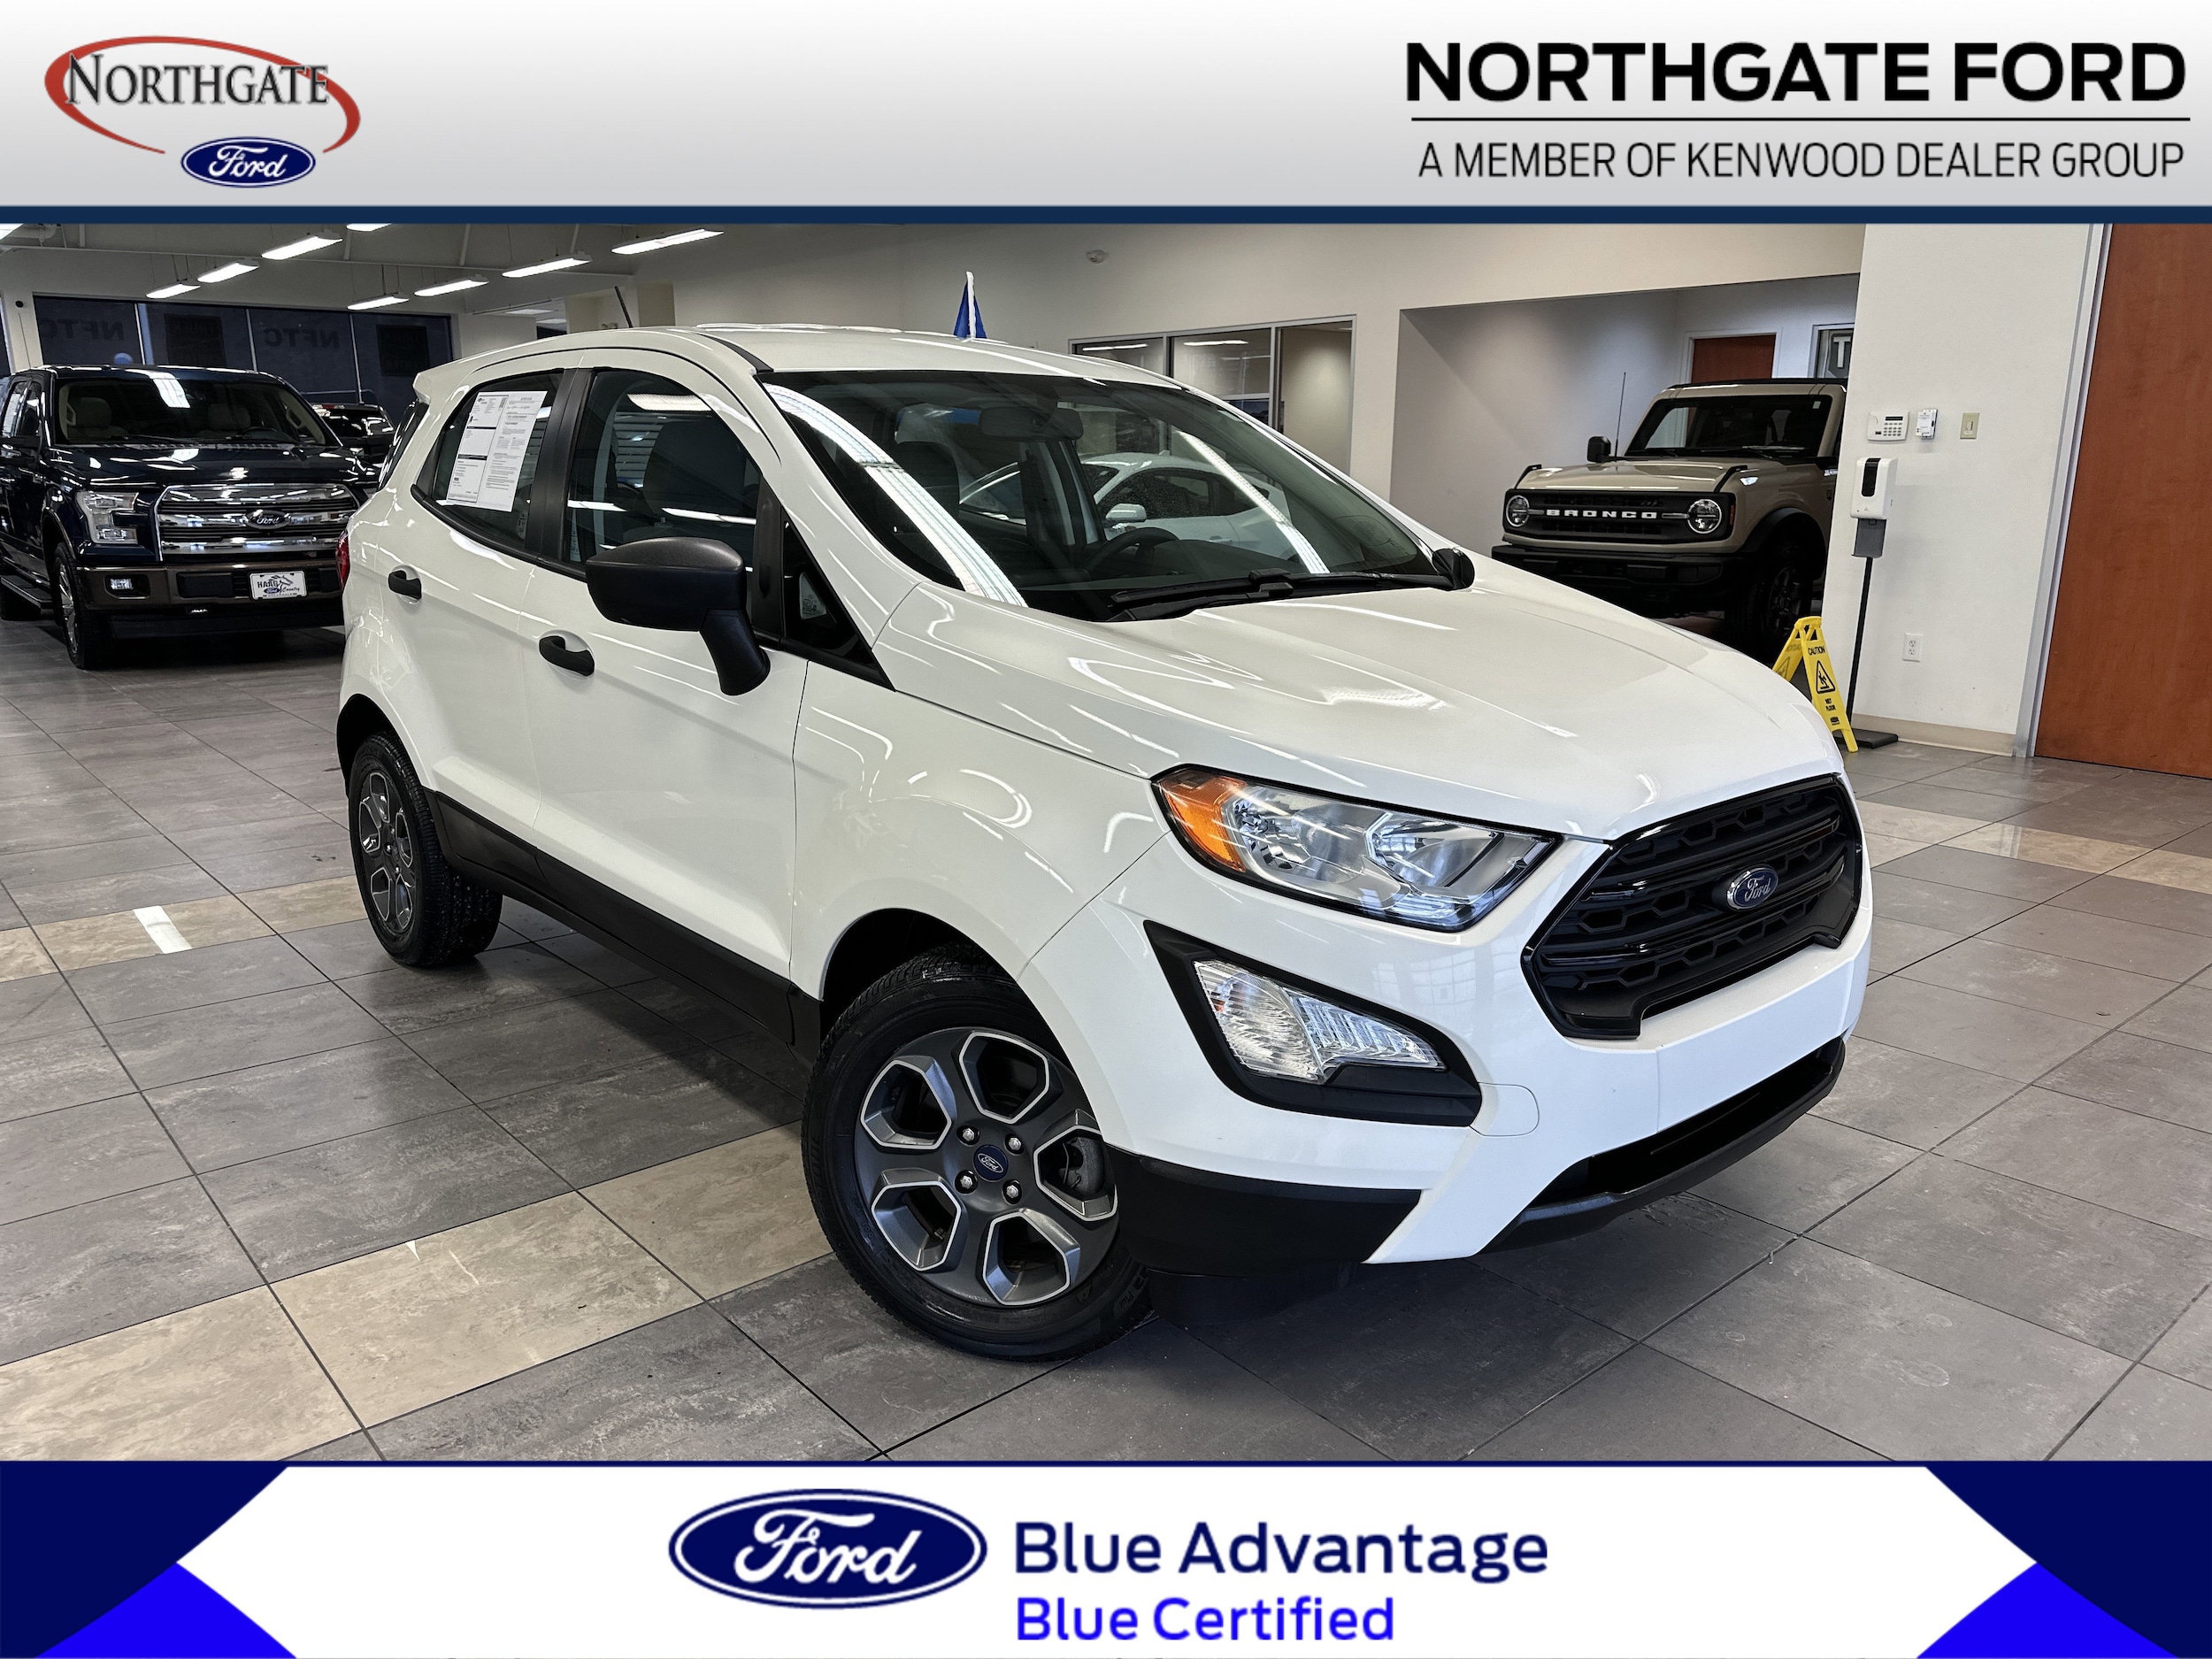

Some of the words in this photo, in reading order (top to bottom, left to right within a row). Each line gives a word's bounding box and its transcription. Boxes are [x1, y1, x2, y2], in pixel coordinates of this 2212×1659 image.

[257, 514, 280, 525] Ford
[1546, 509, 1657, 519] BRONCO
[1808, 646, 1825, 656] CAUTION
[1744, 874, 1771, 902] Ford
[981, 1156, 999, 1170] Ford
